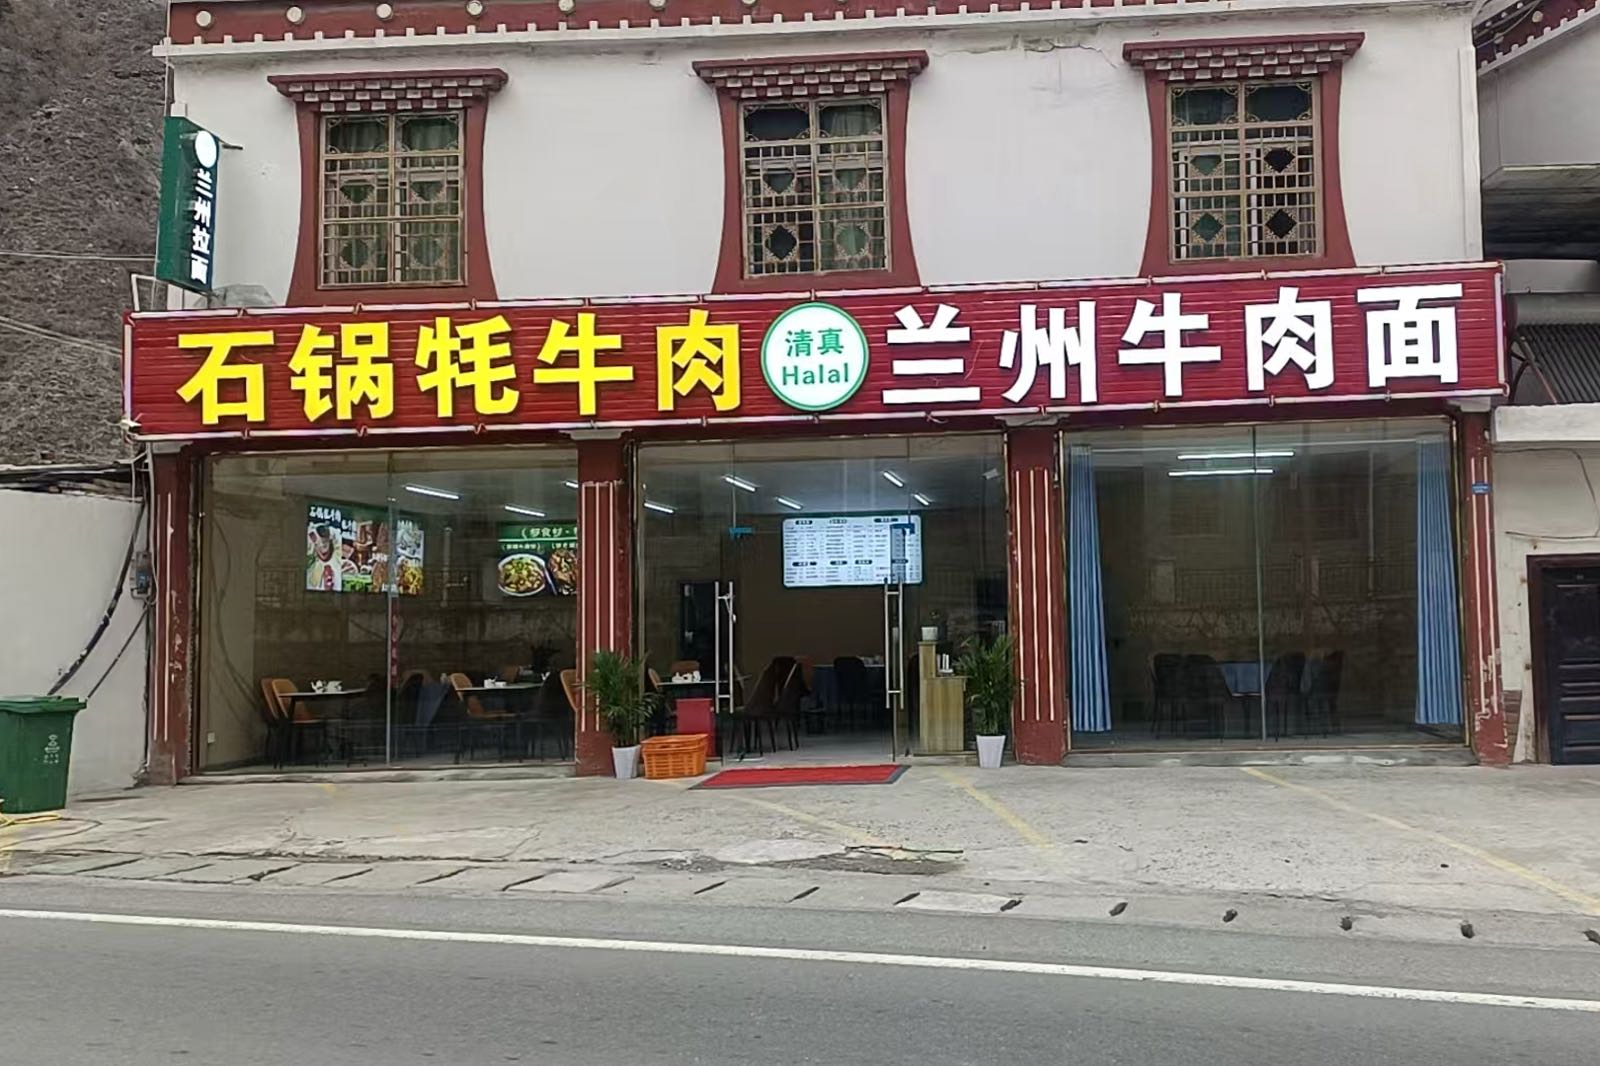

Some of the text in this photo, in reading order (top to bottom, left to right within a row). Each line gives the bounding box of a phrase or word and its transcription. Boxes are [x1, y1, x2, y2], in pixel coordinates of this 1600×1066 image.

[191, 168, 214, 284] 兰州拉面
[177, 308, 740, 423] 石锅牦牛肉
[782, 362, 849, 386] Halal
[785, 328, 844, 357] 清真
[882, 283, 1463, 404] 兰州牛肉面
